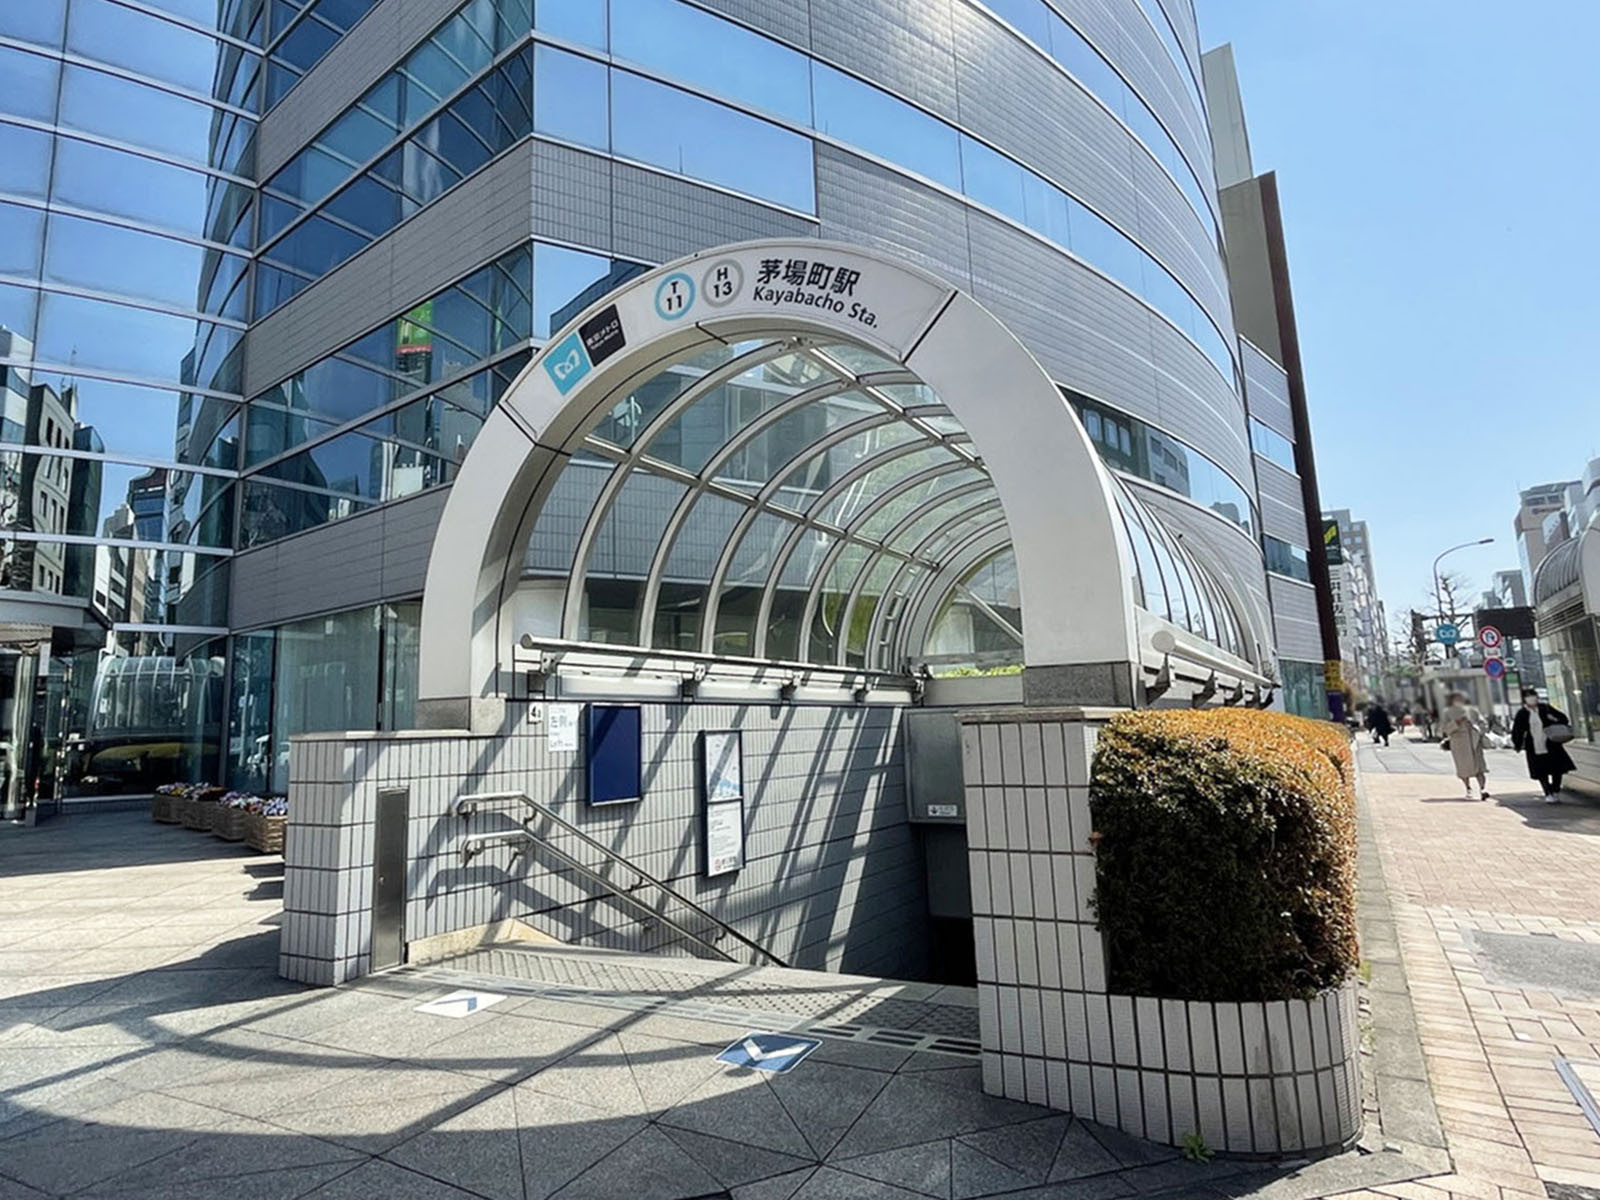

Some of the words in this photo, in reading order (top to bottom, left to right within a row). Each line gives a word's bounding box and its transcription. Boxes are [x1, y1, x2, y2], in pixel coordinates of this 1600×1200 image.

[717, 267, 728, 281] H
[757, 259, 861, 296] 茅場町駅
[671, 281, 678, 294] T
[714, 281, 732, 298] 13
[667, 295, 682, 311] 11
[753, 286, 844, 313] Kayabacho
[848, 302, 878, 329] Sta.
